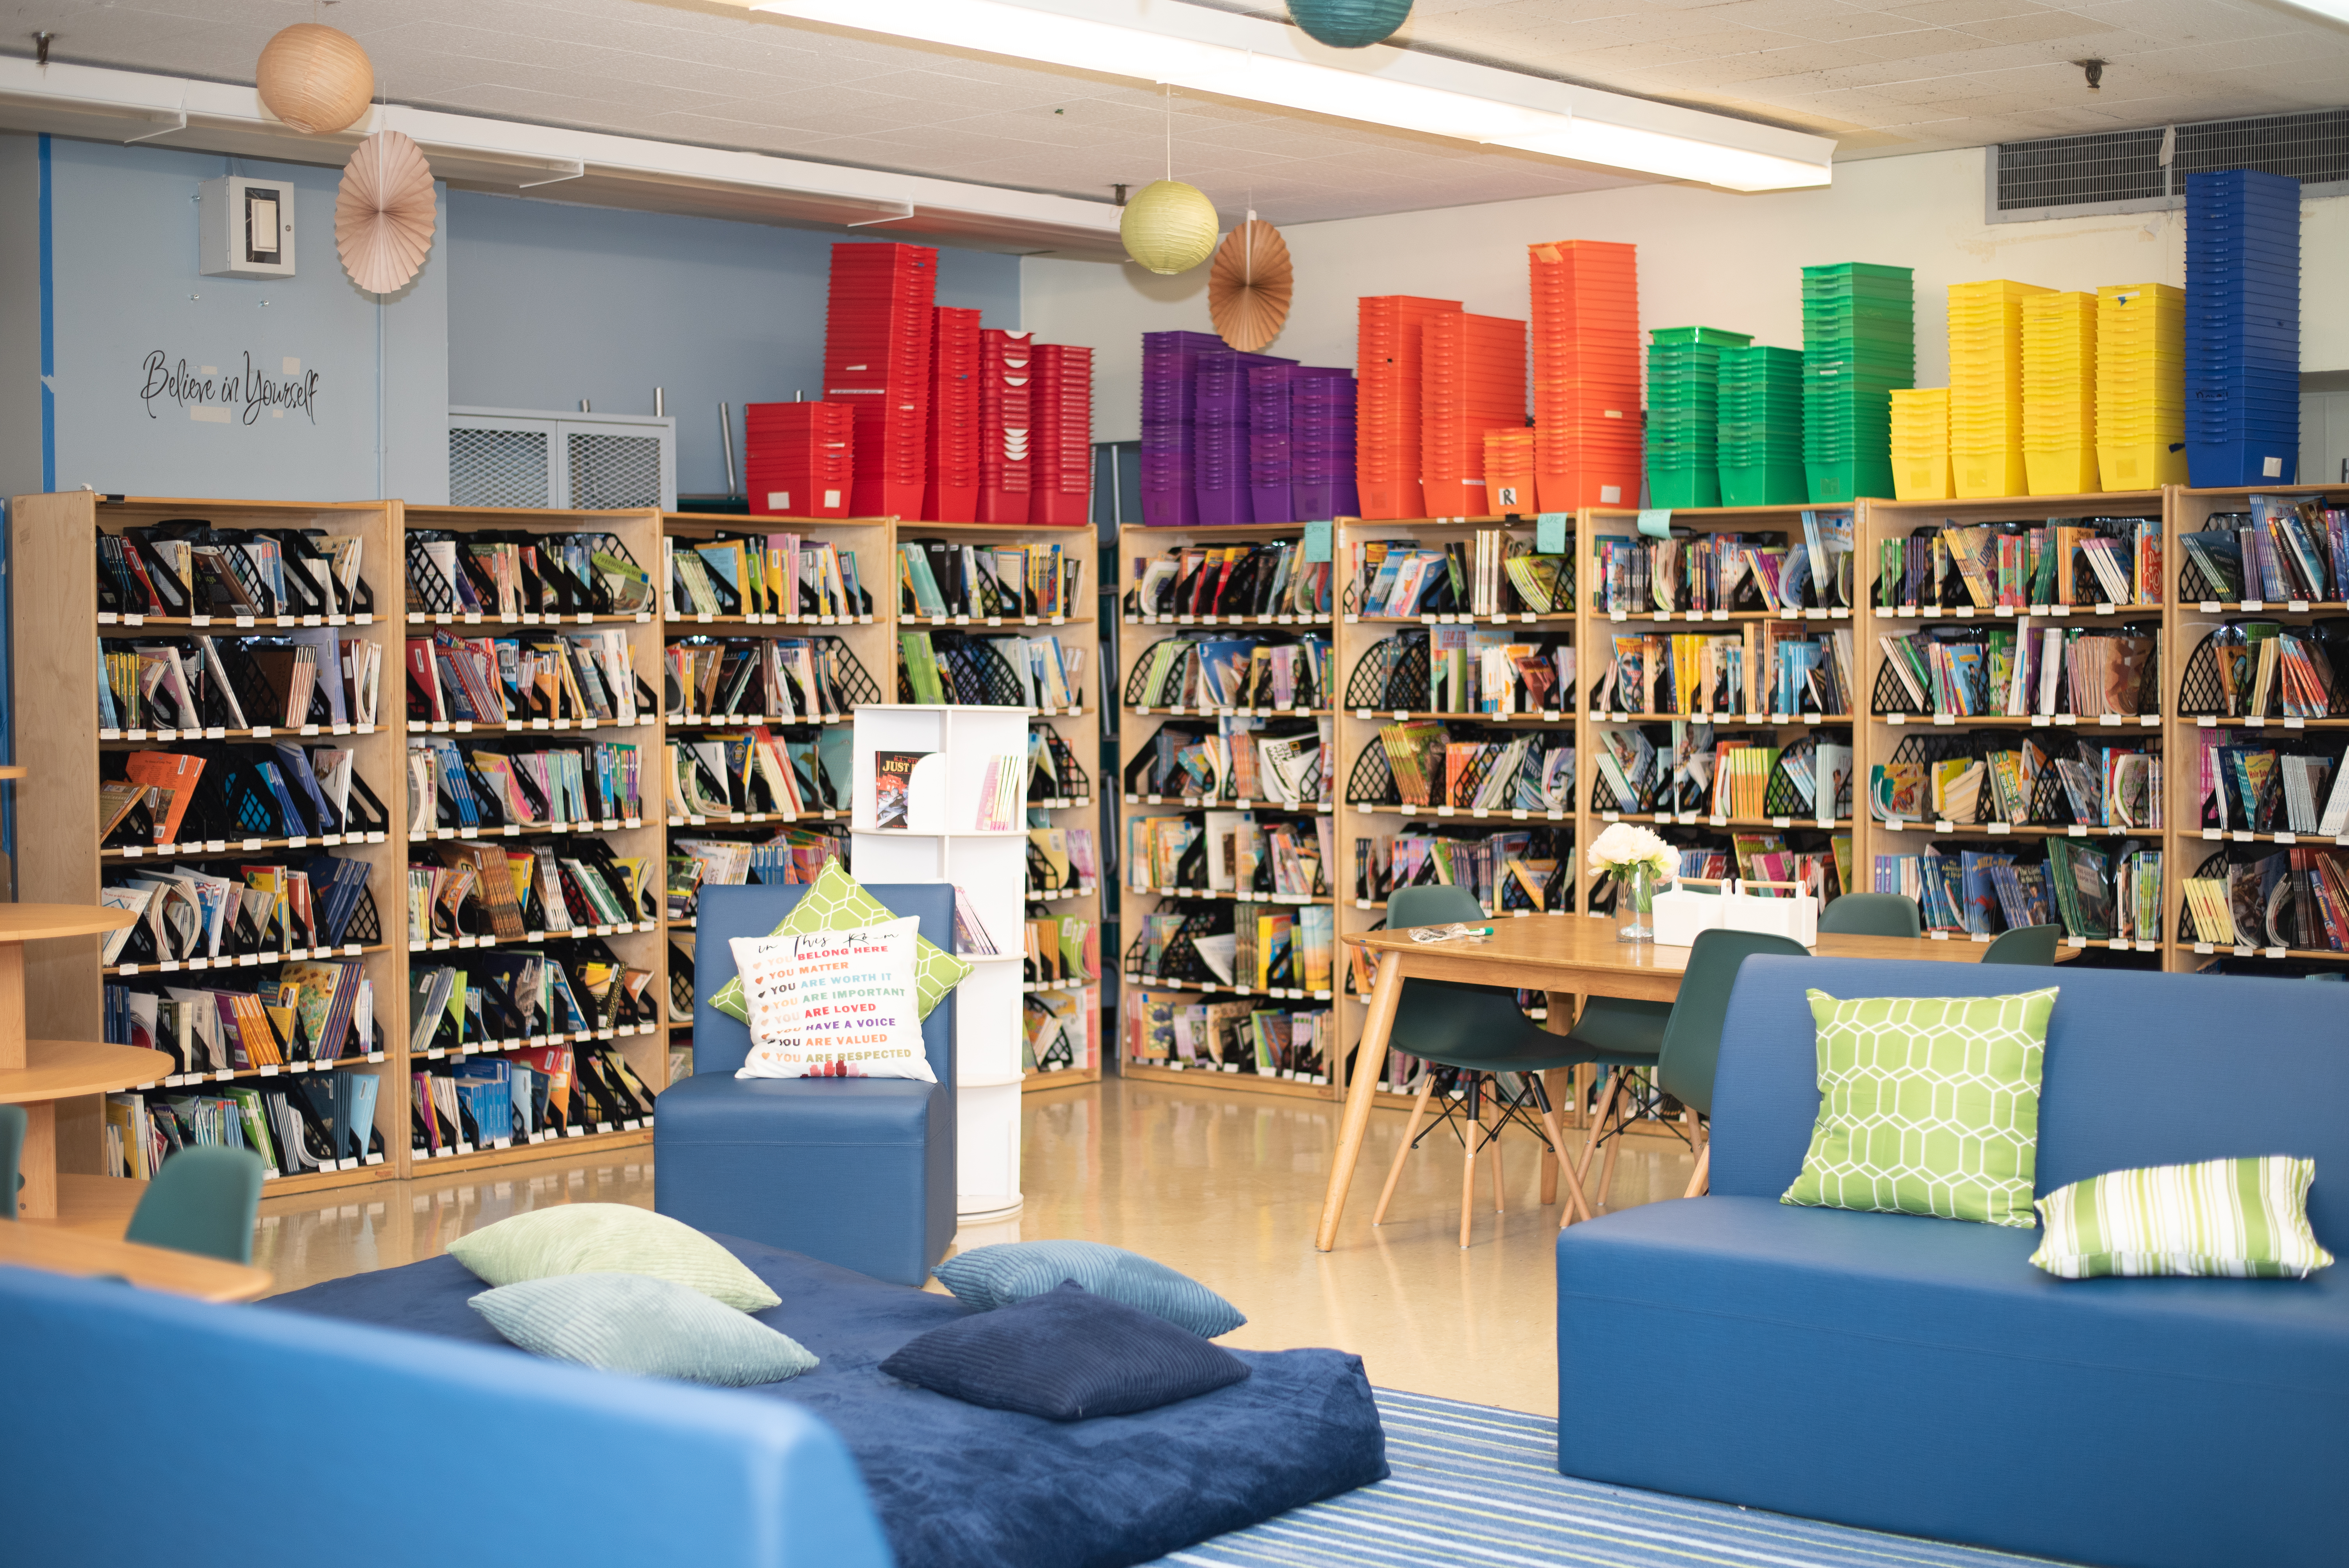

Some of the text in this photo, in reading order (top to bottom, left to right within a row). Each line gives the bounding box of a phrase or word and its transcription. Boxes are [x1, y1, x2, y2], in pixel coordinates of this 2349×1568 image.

[140, 350, 319, 426] Believe in Yourself
[1503, 489, 1515, 504] R
[2302, 522, 2312, 539] AMULET
[598, 556, 623, 569] FREEDOM
[882, 761, 910, 772] JUST
[767, 946, 888, 966] YOU BELONG HERE
[769, 962, 849, 980] YOU MATTER
[771, 973, 892, 995] YOU ARE WORTH IT
[773, 988, 905, 1010] YOU ARE IMPORTANT
[775, 1003, 877, 1024] YOU ARE LOVED
[806, 1021, 839, 1031] HAVE
[845, 1020, 853, 1028] A
[857, 1018, 896, 1027] VOICE
[806, 1037, 832, 1047] ARE
[836, 1034, 888, 1045] VALUED
[776, 1049, 912, 1063] YOU ARE RESPECTED
